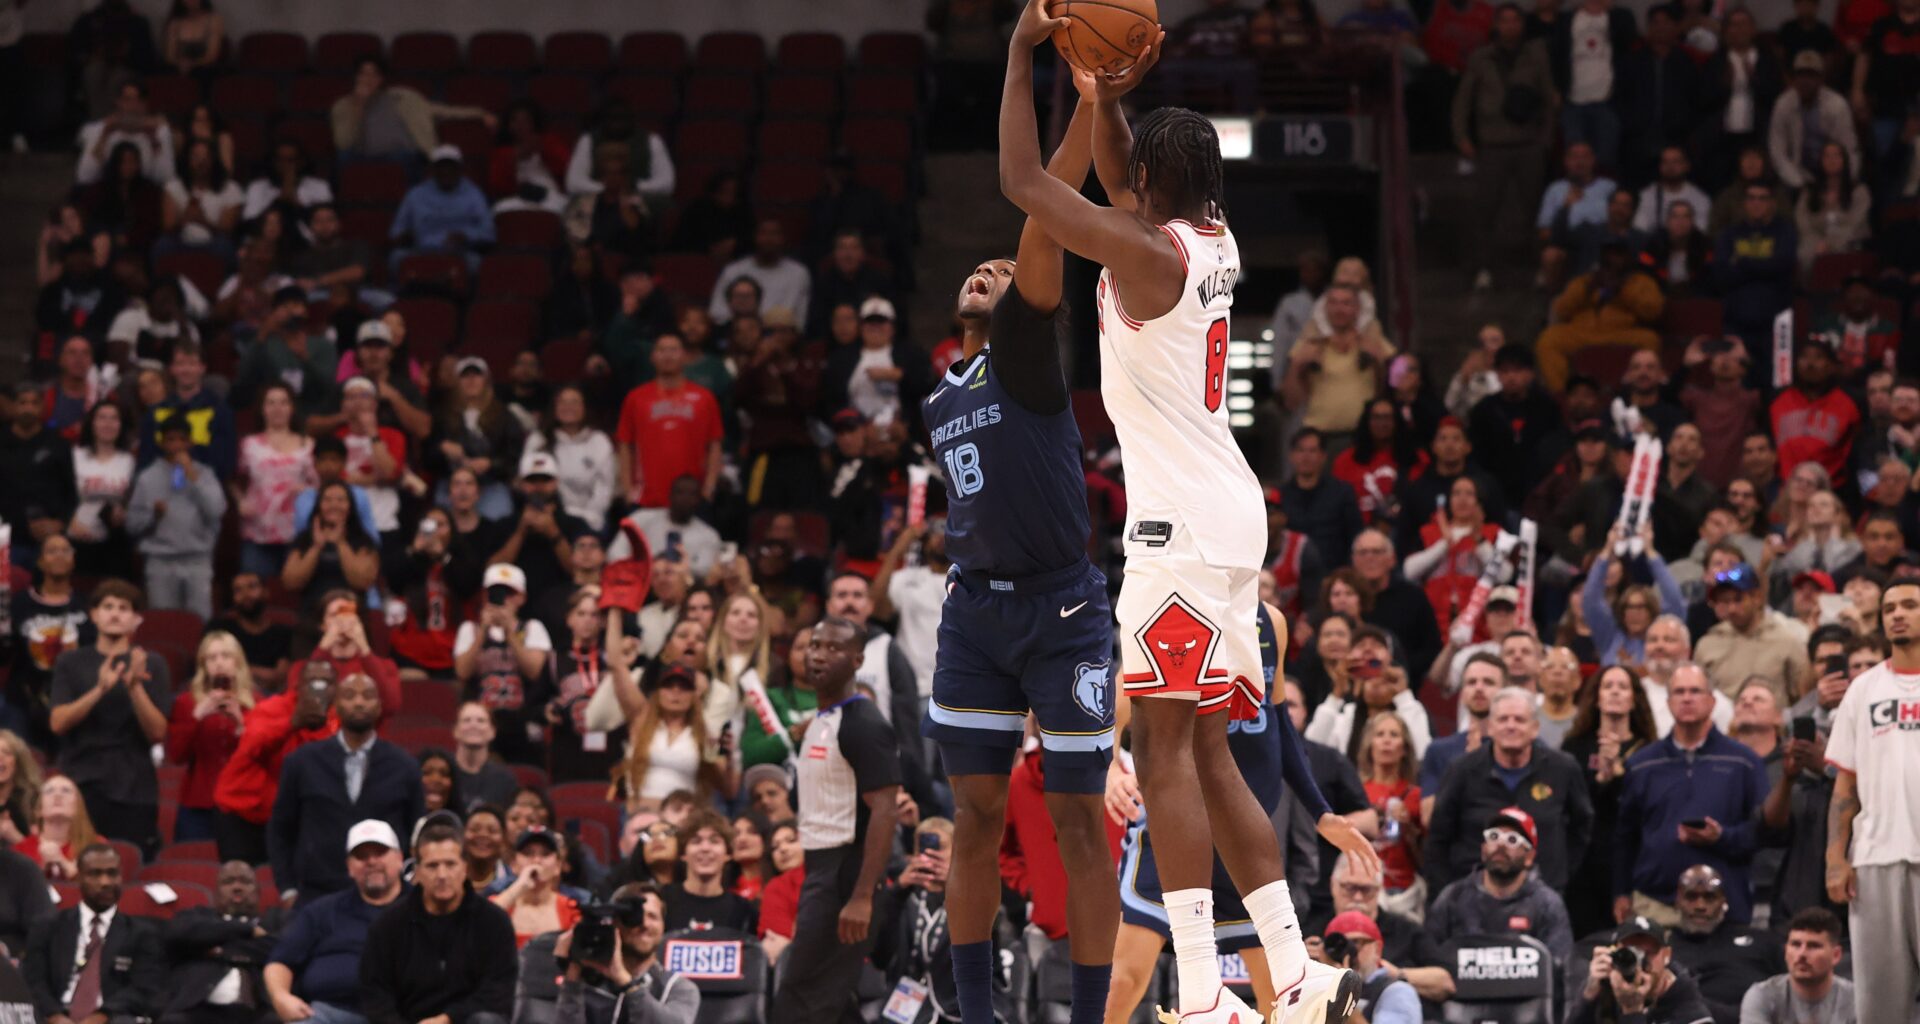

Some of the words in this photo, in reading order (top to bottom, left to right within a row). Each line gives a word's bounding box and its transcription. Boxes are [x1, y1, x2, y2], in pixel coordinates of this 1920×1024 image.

[1205, 316, 1229, 414] 8
[931, 403, 1002, 449] GRIZZLIES
[944, 442, 985, 498] 18
[1870, 699, 1920, 727] CH
[681, 945, 726, 974] USO
[1457, 946, 1540, 966] FIELD
[1457, 964, 1539, 979] MUSEUM
